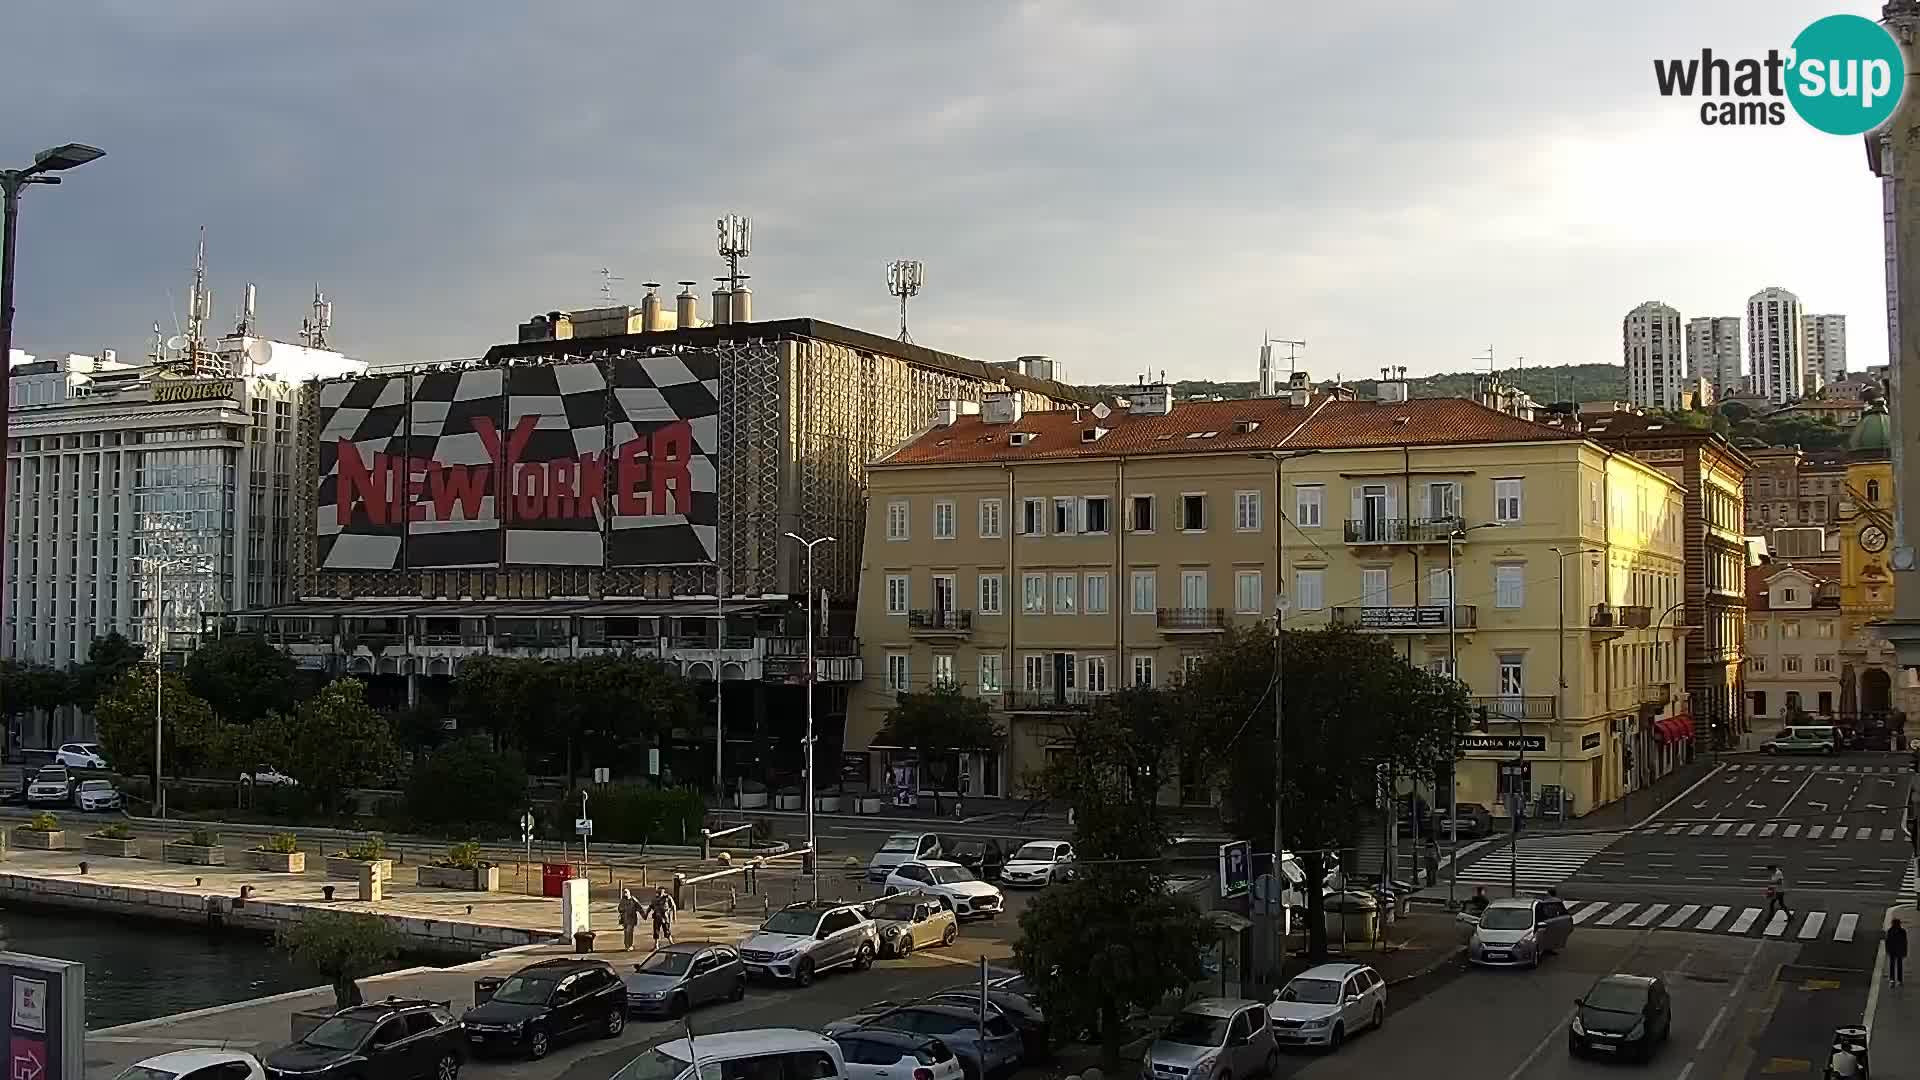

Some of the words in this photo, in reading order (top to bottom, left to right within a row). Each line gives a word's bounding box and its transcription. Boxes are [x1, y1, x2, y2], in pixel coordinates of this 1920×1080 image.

[336, 435, 490, 526] NEW
[471, 414, 693, 523] YORKER
[1459, 739, 1504, 747] JULIANA
